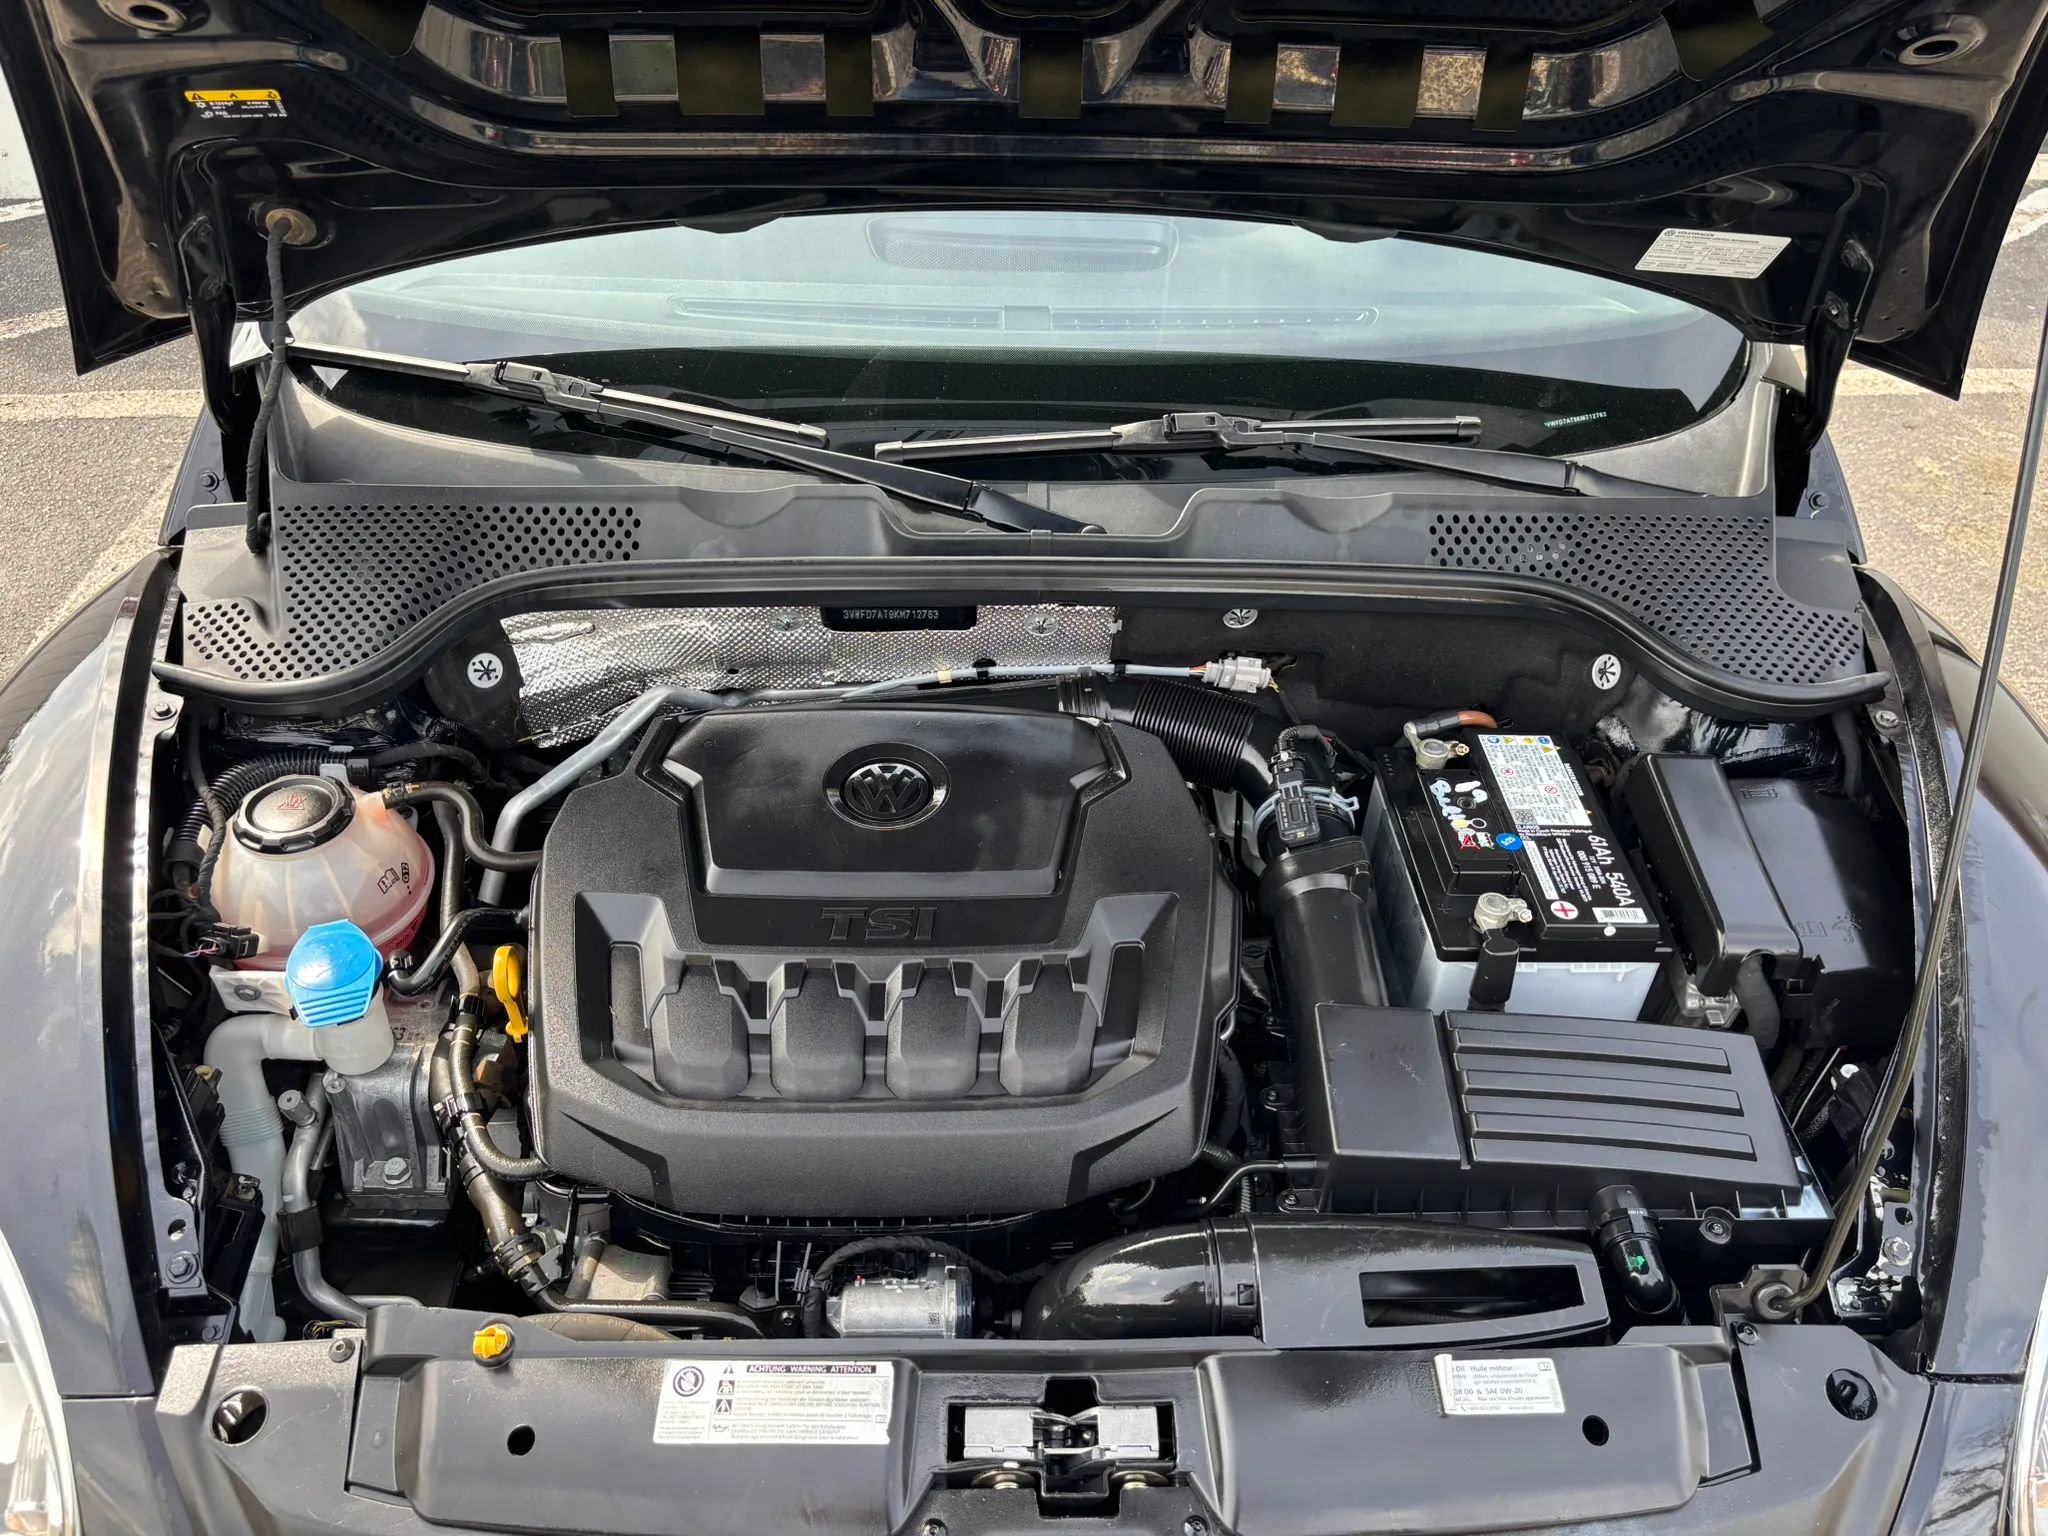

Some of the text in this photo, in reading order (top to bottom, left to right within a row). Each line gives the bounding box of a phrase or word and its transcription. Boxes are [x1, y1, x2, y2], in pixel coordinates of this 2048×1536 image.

[1588, 835, 1636, 906] 61Ah 540A
[821, 907, 938, 940] TSI
[748, 1365, 873, 1374] ACHTUNG WARNING ATTENTION
